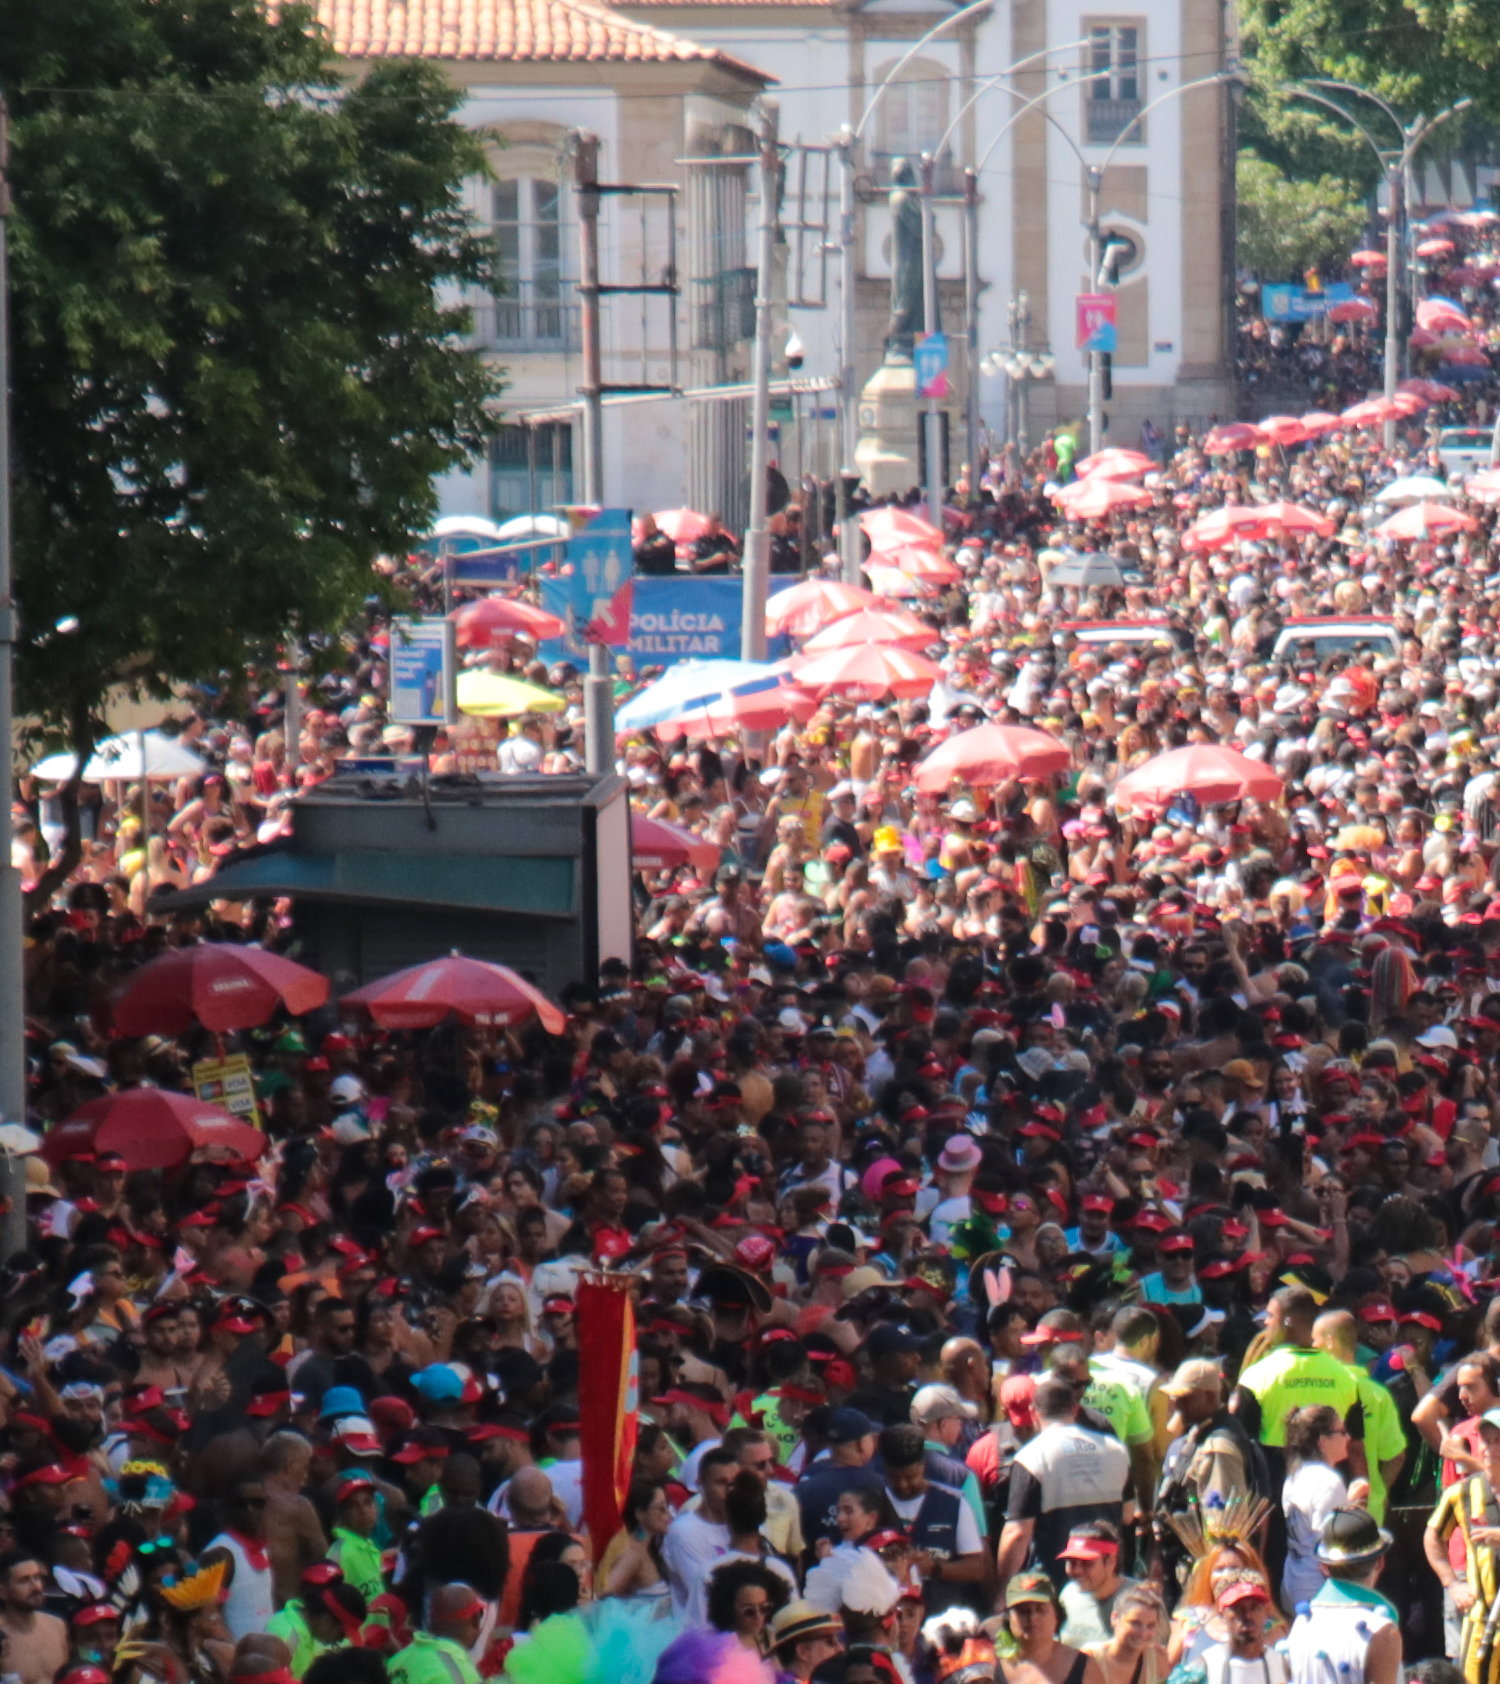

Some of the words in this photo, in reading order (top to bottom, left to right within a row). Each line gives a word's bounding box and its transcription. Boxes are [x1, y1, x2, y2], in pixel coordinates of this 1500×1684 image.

[628, 610, 724, 632] POLÍCIA
[628, 634, 720, 653] MILITAR
[1283, 1376, 1336, 1390] SUPERVISOR
